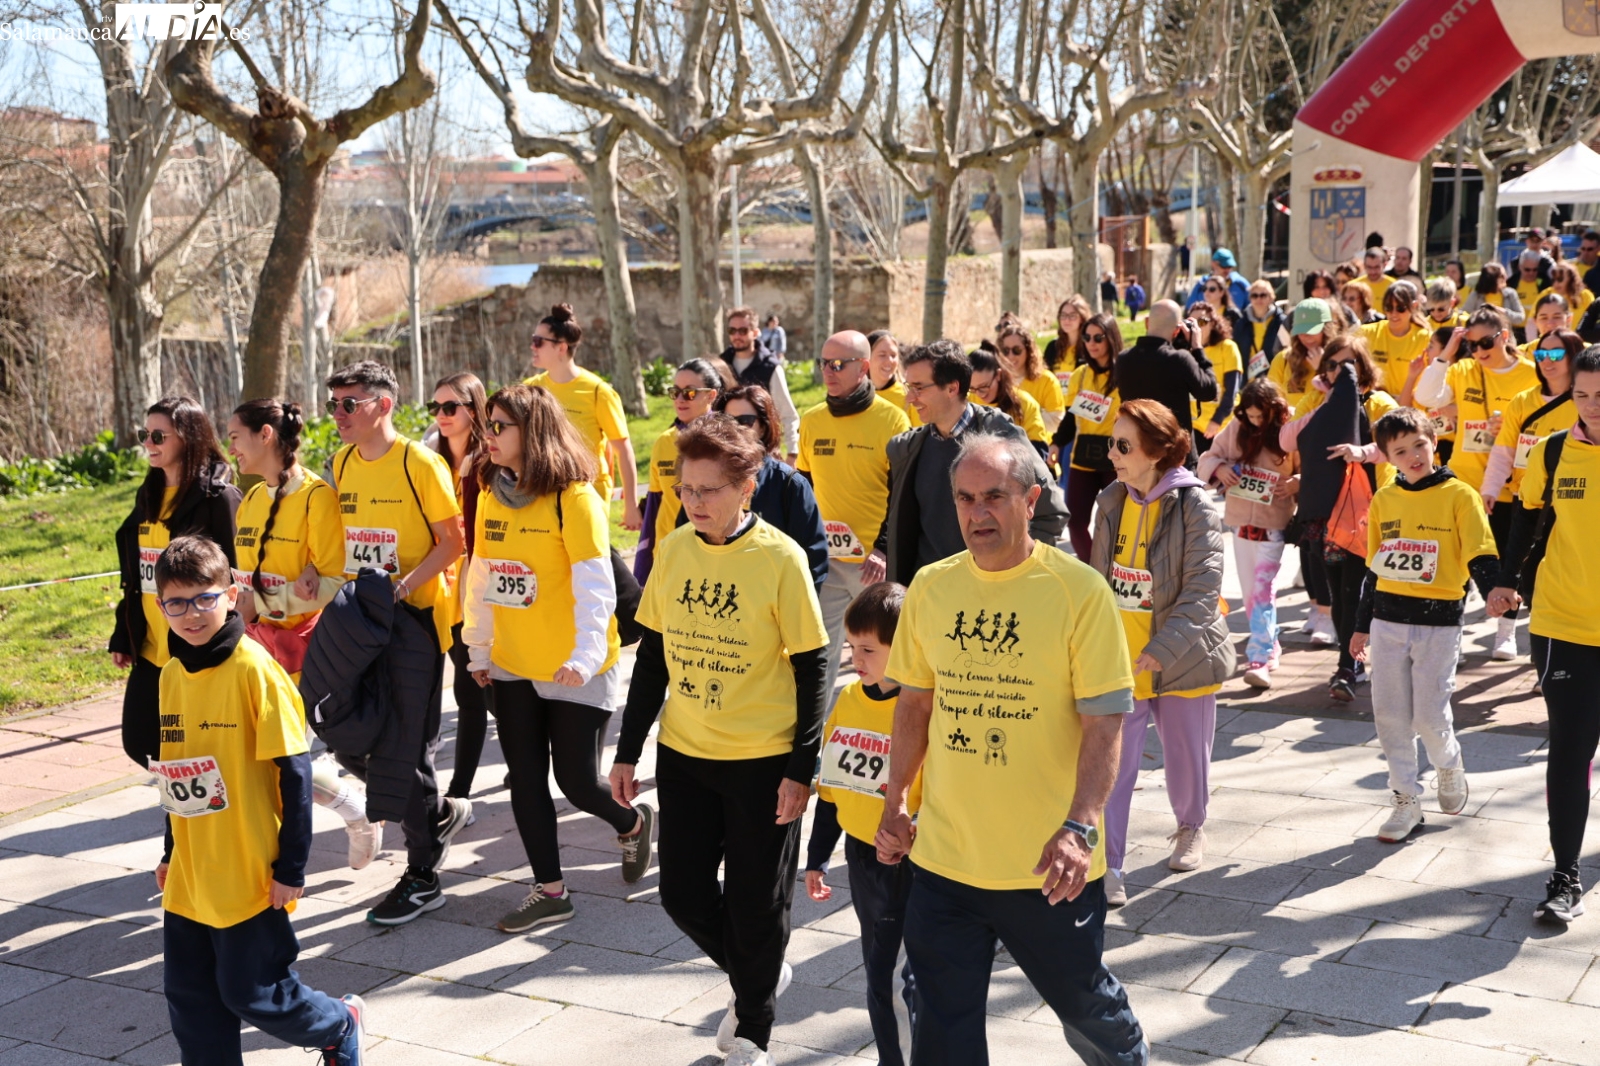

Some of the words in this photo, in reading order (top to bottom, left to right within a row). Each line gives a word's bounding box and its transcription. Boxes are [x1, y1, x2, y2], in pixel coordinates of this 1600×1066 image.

[1331, 95, 1371, 136] CON
[1369, 74, 1398, 99] EL
[1079, 400, 1101, 415] 446
[1241, 469, 1278, 483] edunia
[1239, 476, 1267, 494] 355
[346, 529, 396, 544] bedunia
[353, 544, 382, 564] 441
[1379, 541, 1437, 554] bedunia
[1384, 552, 1423, 571] 428
[496, 575, 526, 596] 395
[696, 657, 706, 670] el
[966, 671, 995, 683] Carrera
[997, 673, 1035, 687] Solidaria
[945, 687, 982, 698] prevención
[984, 689, 995, 699] del
[996, 692, 1026, 702] suicidio
[972, 702, 985, 718] el
[829, 729, 892, 756] beduni
[838, 749, 884, 781] 429
[166, 777, 208, 802] 06
